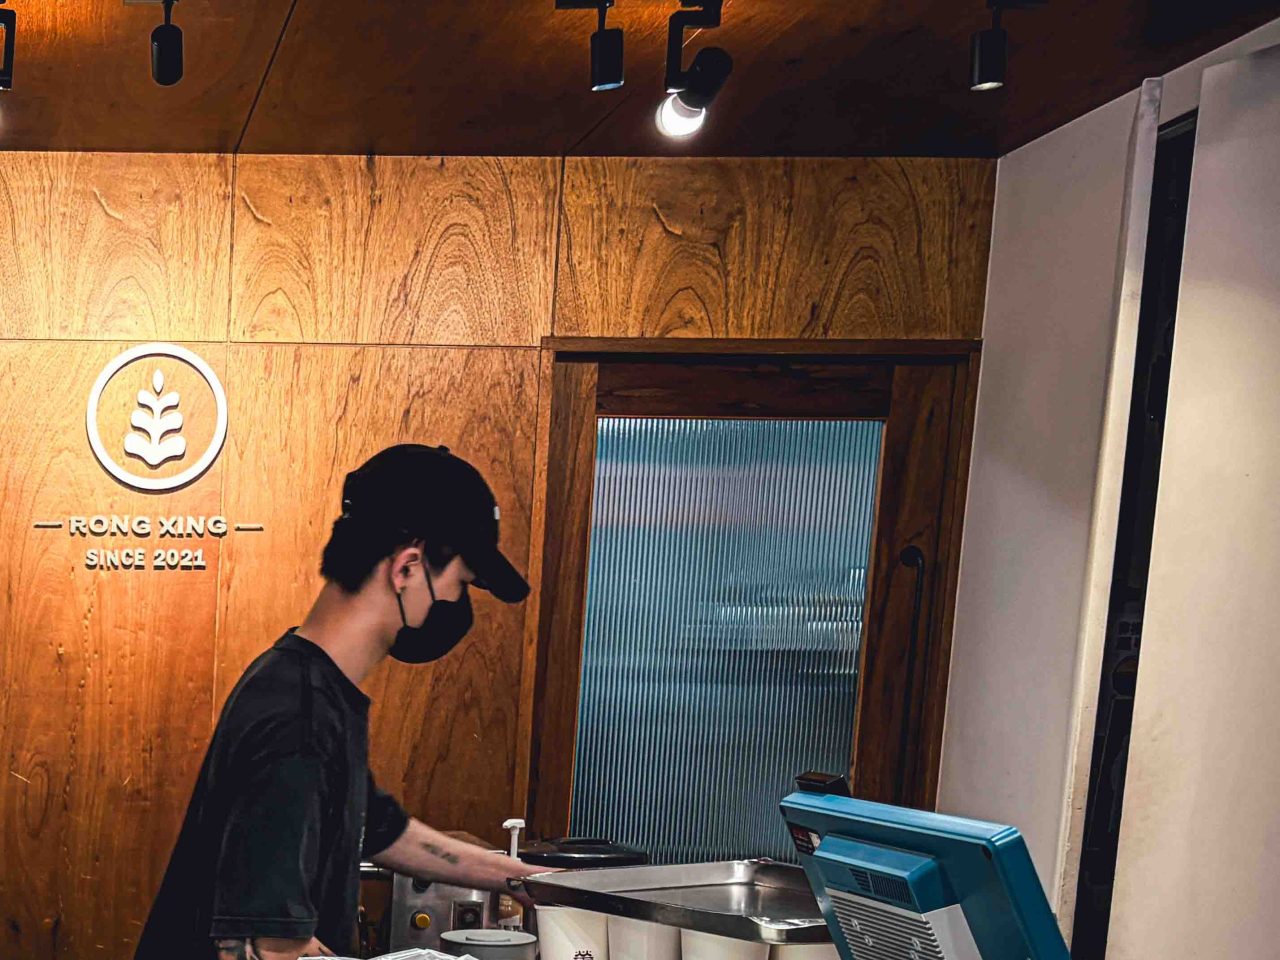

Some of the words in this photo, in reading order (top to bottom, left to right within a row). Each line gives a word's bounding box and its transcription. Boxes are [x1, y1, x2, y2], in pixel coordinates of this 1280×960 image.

[69, 514, 151, 537] RONG
[159, 515, 228, 538] XING
[85, 549, 145, 570] SINCE
[153, 549, 206, 570] 2021
